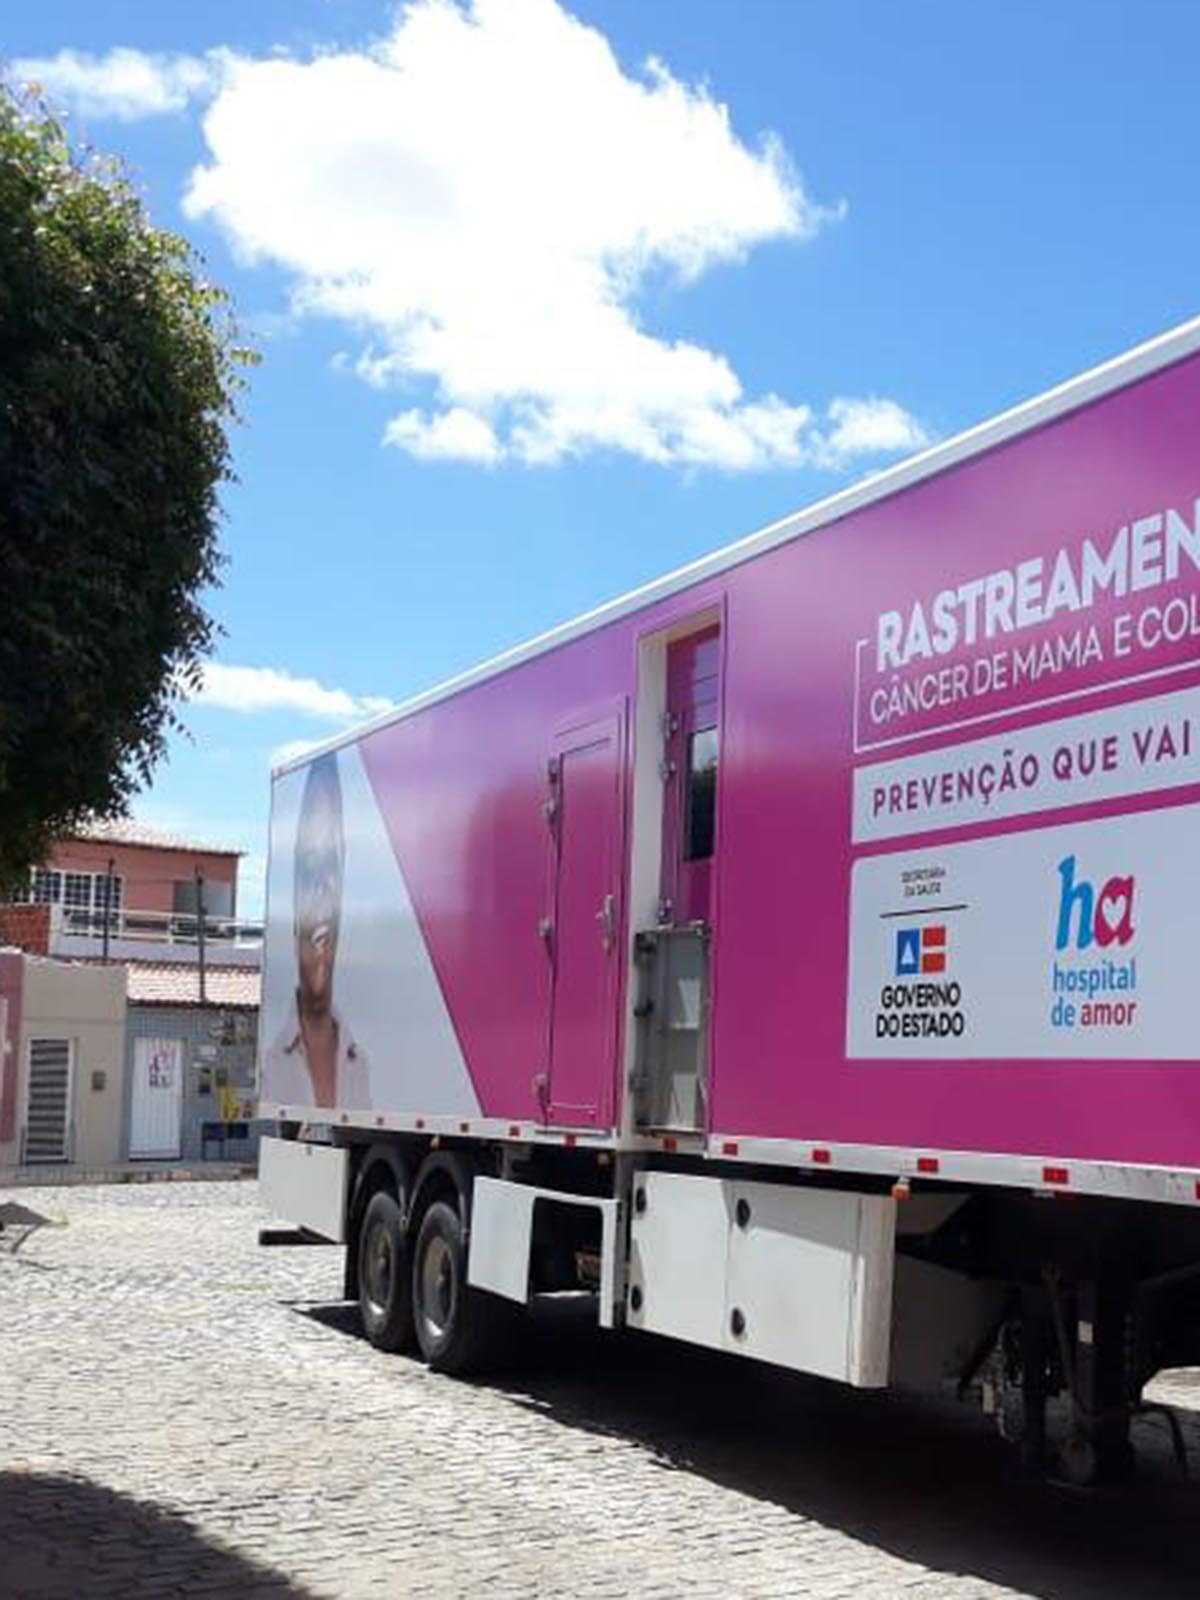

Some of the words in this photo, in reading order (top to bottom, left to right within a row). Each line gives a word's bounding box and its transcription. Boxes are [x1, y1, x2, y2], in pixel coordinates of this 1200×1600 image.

[870, 665, 968, 723] CÂNCER
[974, 652, 1007, 696] DE
[1012, 626, 1103, 684] MAMA
[1114, 612, 1132, 657] E
[872, 749, 1039, 818] PREVENÇÃO
[1052, 736, 1118, 780] QUE
[1132, 719, 1190, 764] VAI
[1056, 854, 1135, 950] ha
[881, 981, 962, 1009] GOVERNO
[1053, 957, 1136, 999] hospital
[876, 1013, 900, 1038] DO
[901, 1011, 965, 1038] ESTADO
[1051, 996, 1076, 1027] de
[1080, 1002, 1137, 1027] amor
